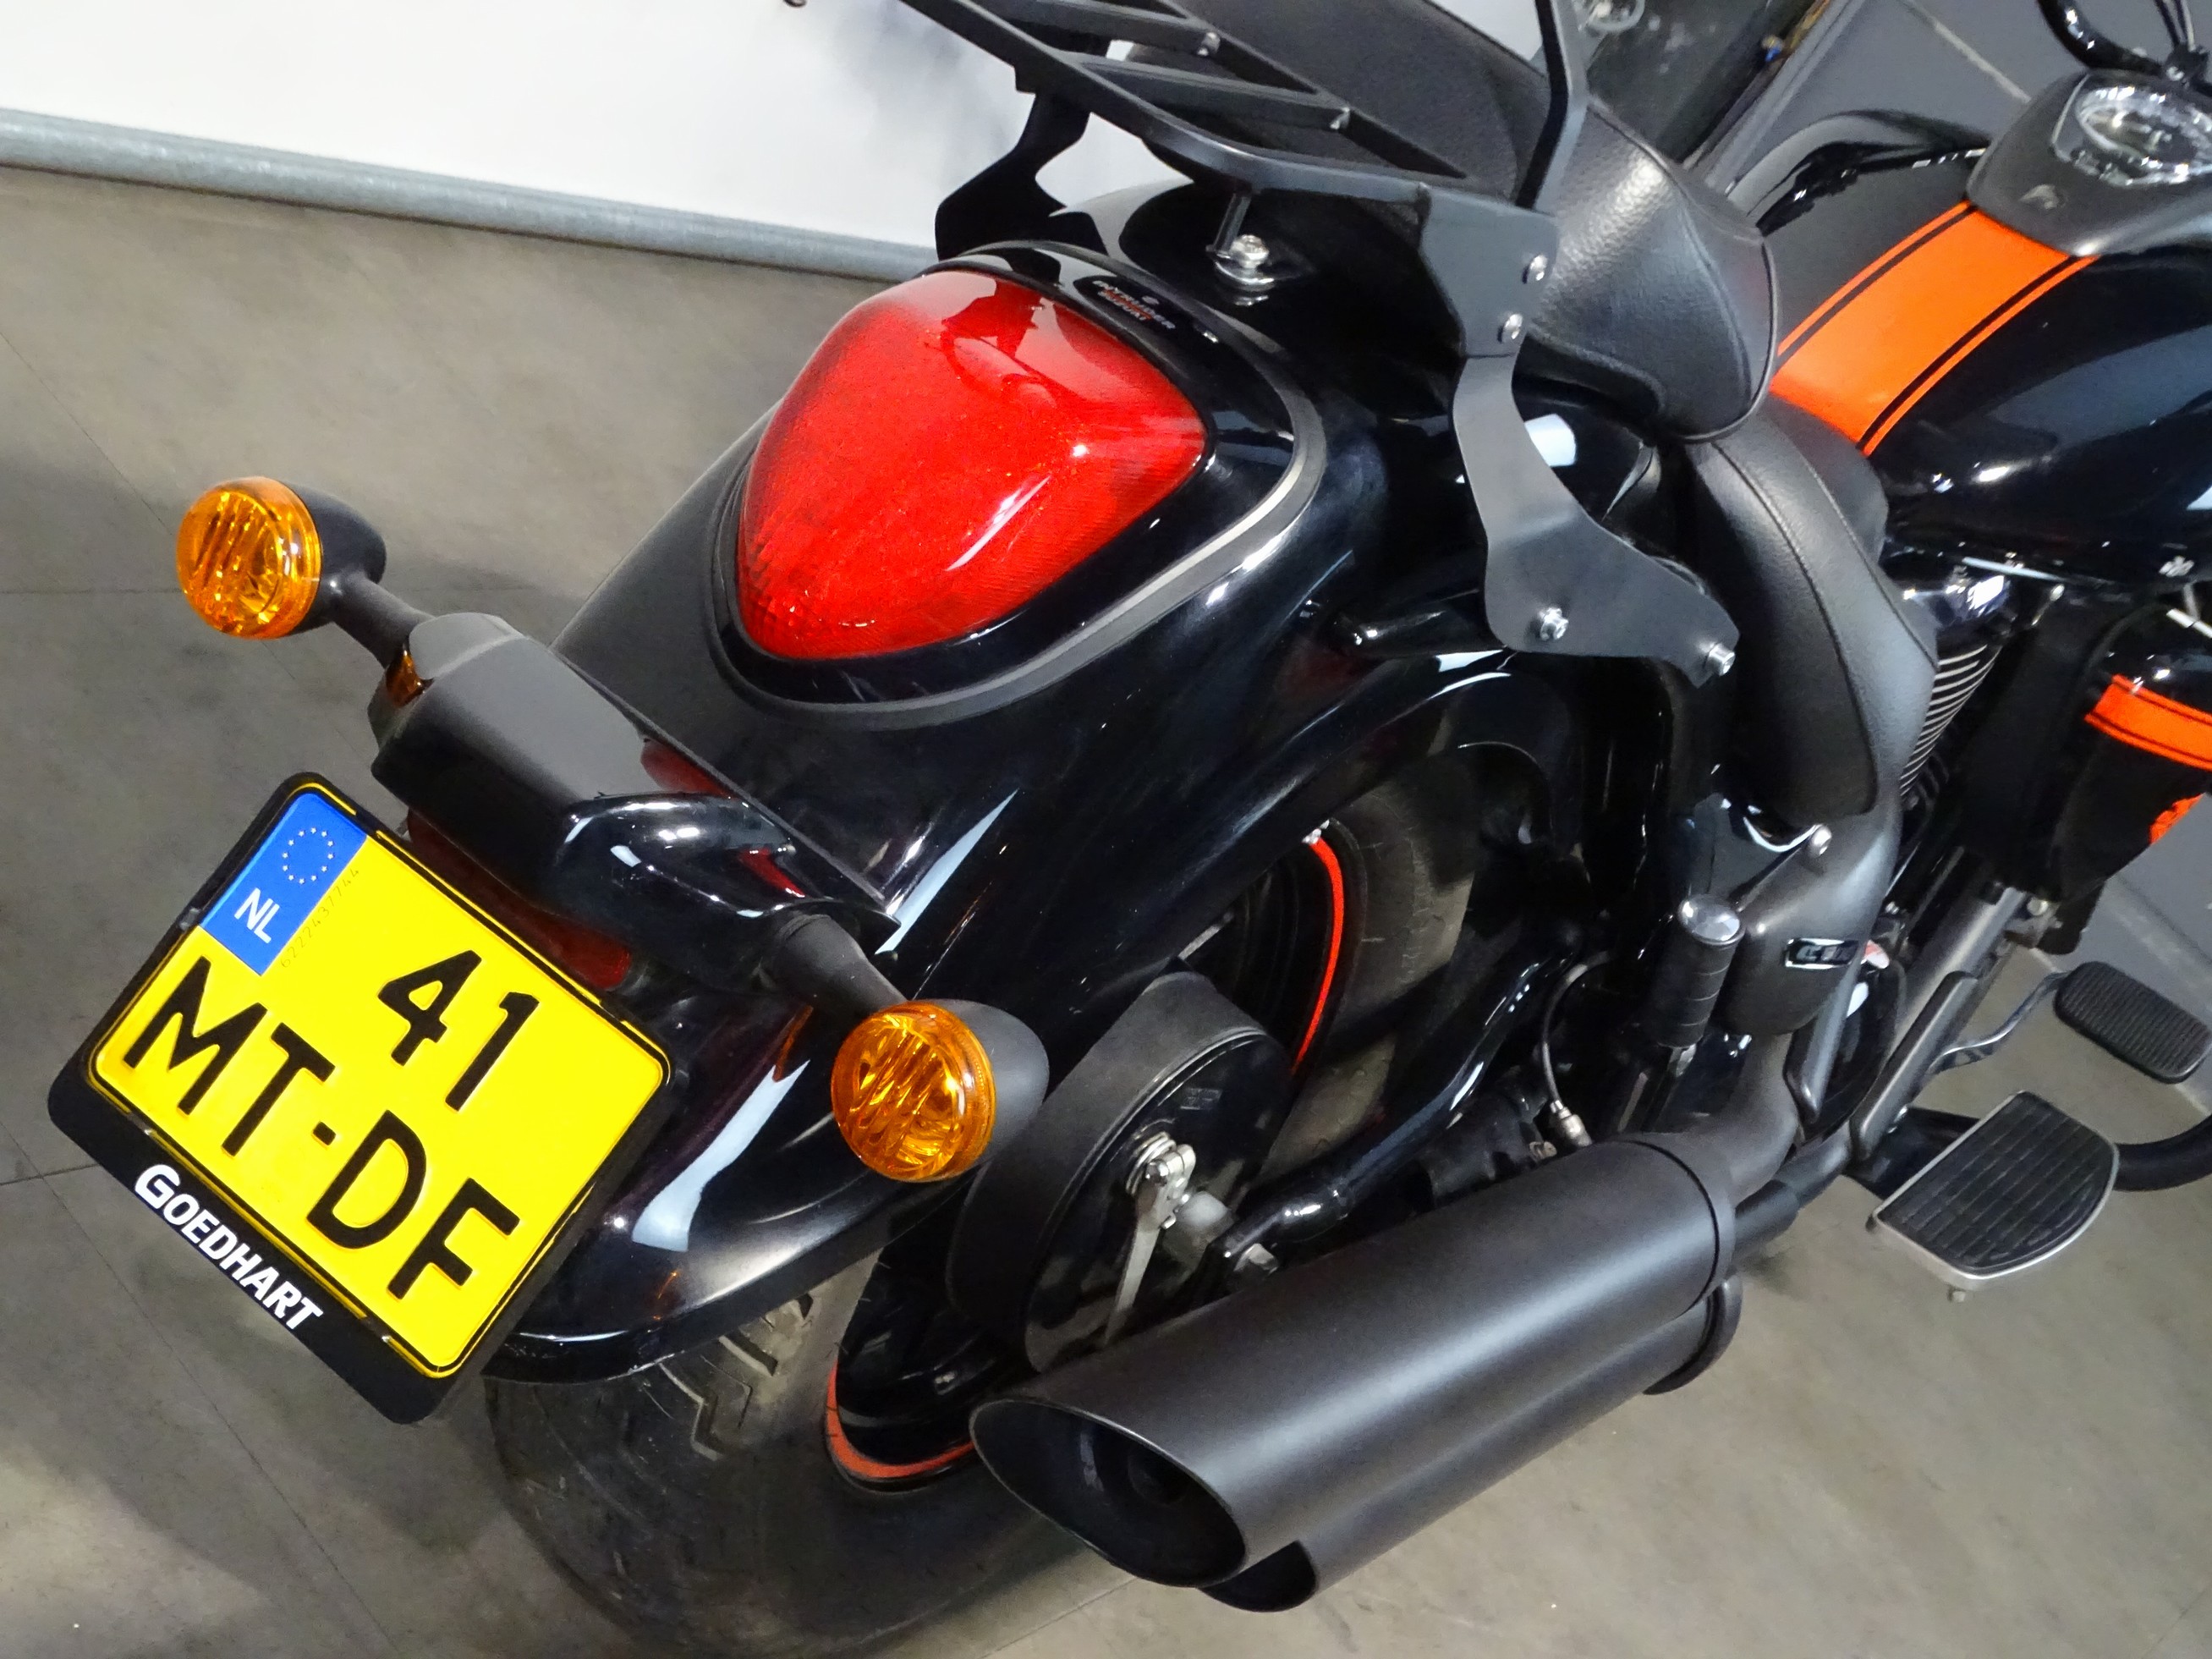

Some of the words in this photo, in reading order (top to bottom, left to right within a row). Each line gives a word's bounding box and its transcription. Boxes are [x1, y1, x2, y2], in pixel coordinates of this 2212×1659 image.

[233, 887, 280, 944] NL
[378, 950, 540, 1110] 41
[123, 957, 519, 1299] MT-DF
[134, 1164, 324, 1330] GOEDHART
